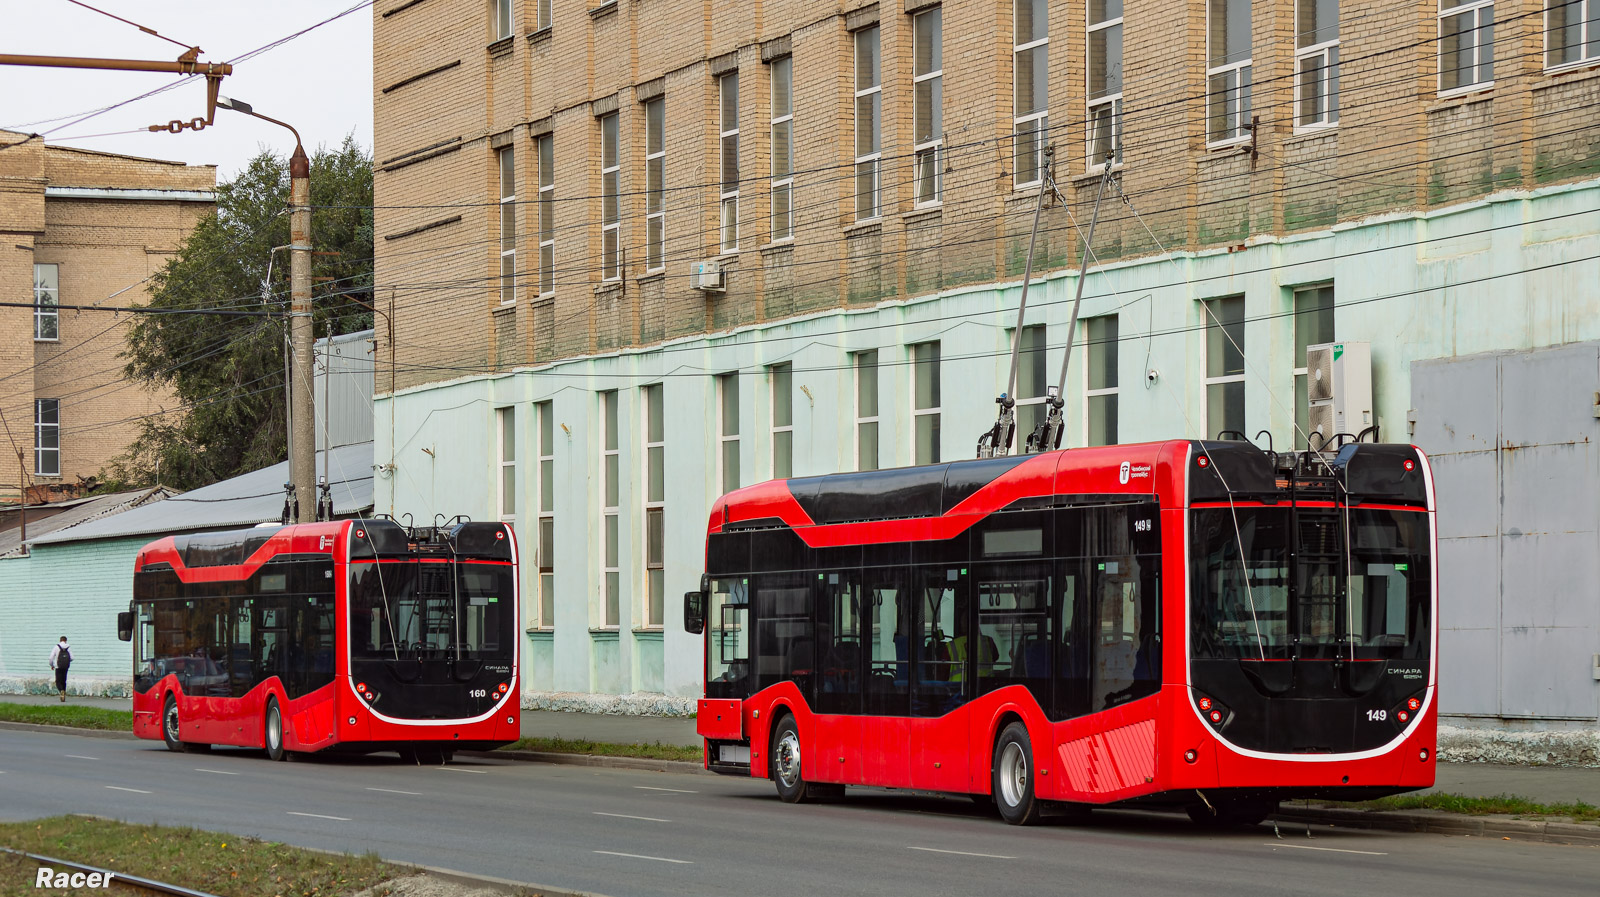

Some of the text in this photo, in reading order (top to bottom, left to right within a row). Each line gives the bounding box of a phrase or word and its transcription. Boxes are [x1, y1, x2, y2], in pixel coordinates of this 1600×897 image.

[1134, 519, 1146, 532] 149
[469, 689, 486, 698] 160
[1366, 709, 1387, 721] 149
